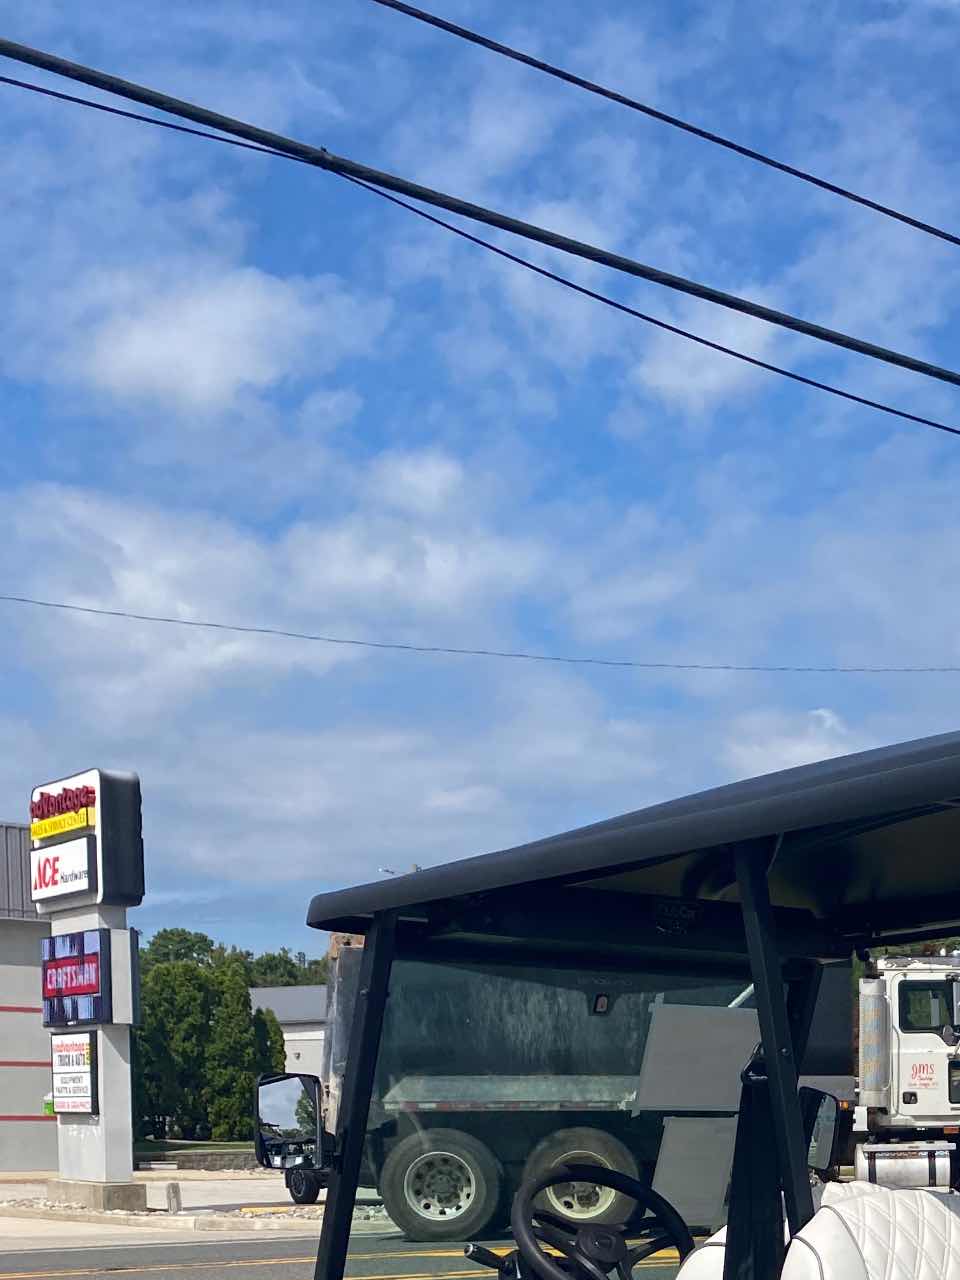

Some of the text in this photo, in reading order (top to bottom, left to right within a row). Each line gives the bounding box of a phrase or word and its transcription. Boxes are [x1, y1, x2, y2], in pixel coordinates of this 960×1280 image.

[33, 855, 60, 890] ACE
[60, 868, 88, 885] Hardware
[46, 962, 97, 990] CRAFTSMAN
